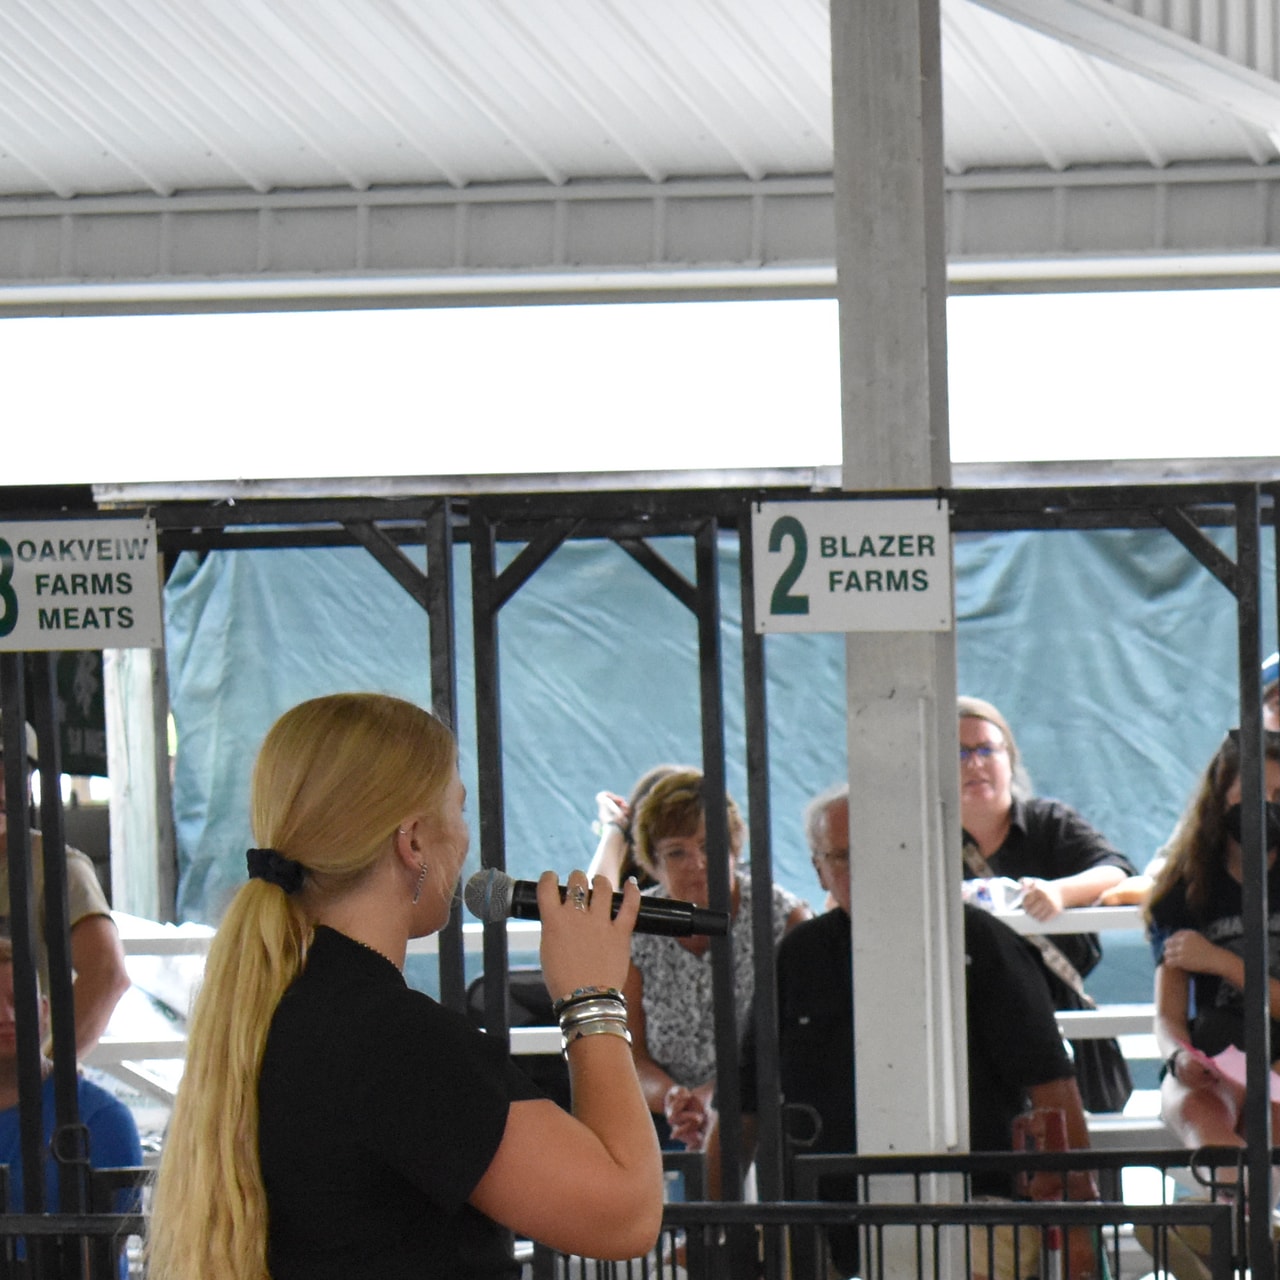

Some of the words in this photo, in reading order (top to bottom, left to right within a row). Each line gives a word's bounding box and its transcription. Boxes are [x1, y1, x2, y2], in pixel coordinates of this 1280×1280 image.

[17, 538, 149, 562] OAKVEIW
[820, 535, 936, 558] BLAZER
[768, 515, 810, 615] 2
[35, 573, 133, 596] FARMS
[829, 569, 929, 592] FARMS
[38, 606, 134, 630] MEATS
